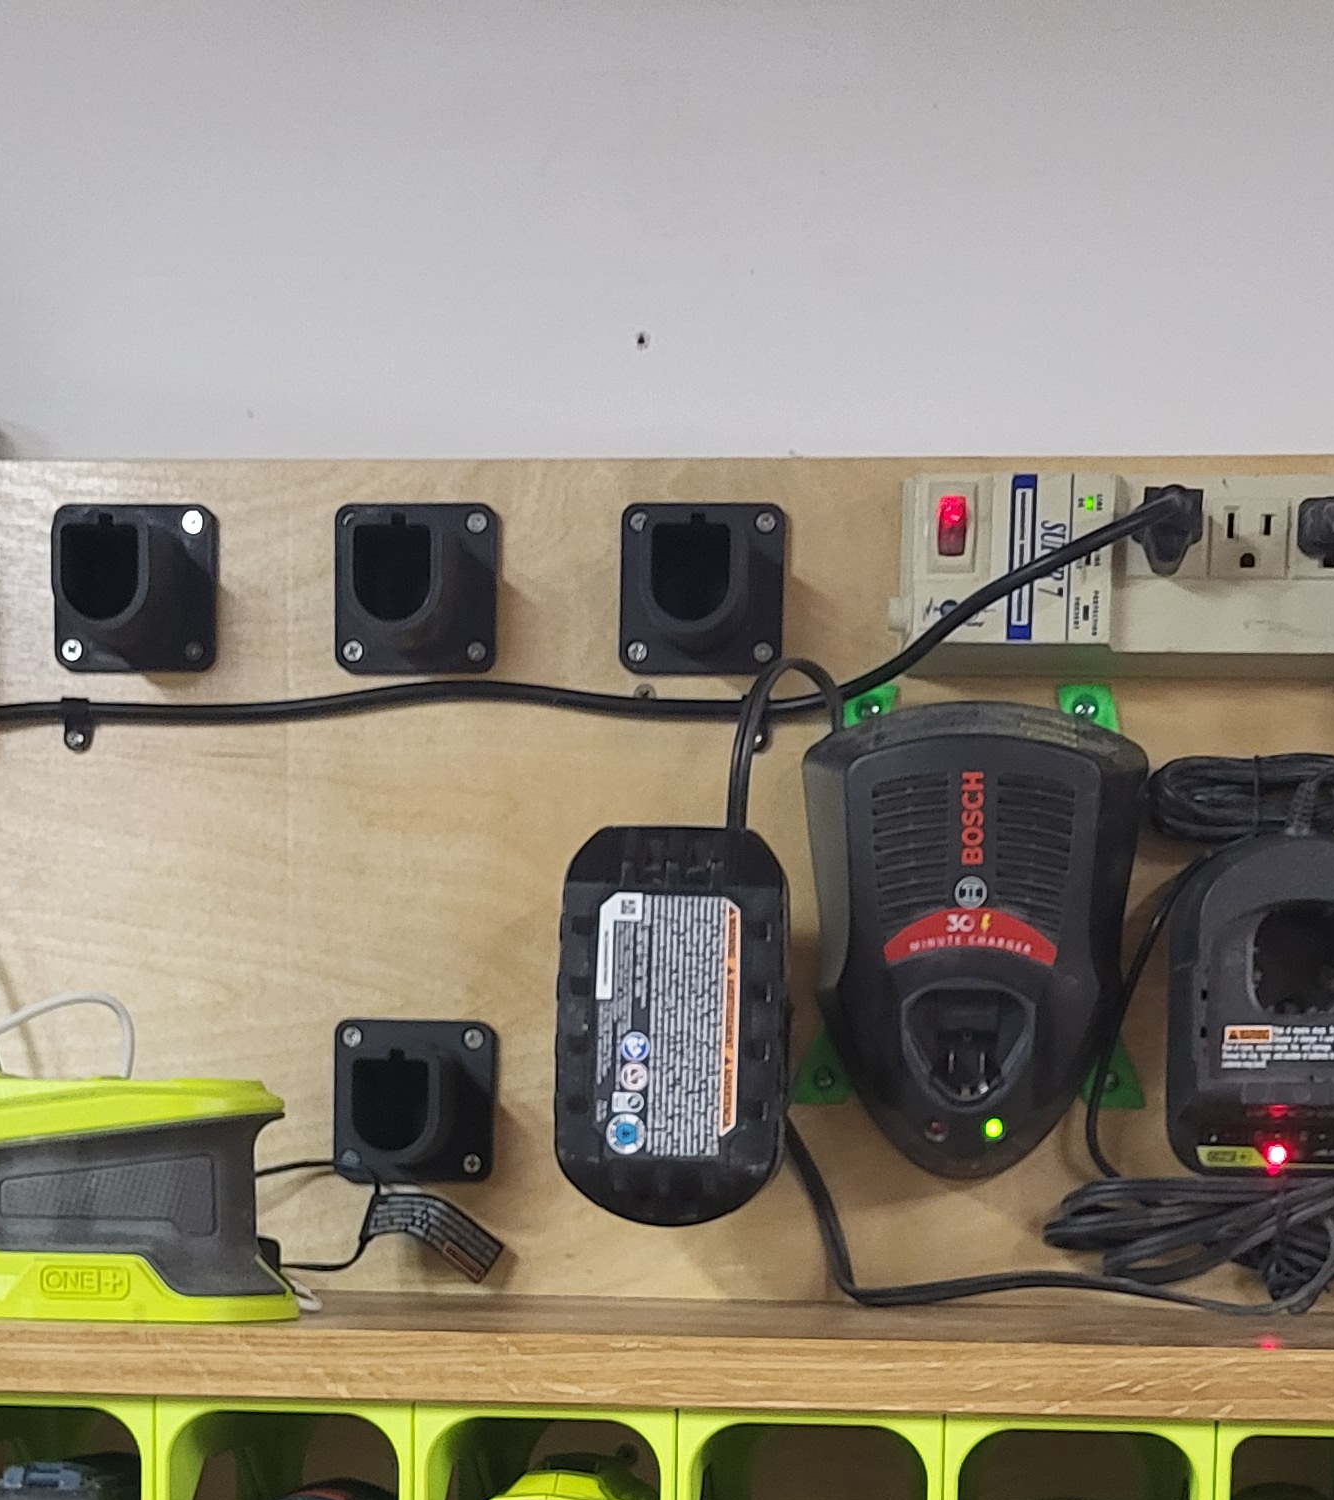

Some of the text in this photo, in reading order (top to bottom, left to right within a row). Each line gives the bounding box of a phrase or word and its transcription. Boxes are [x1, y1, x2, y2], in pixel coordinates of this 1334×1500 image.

[1038, 587, 1064, 598] 7
[961, 770, 984, 865] BOSCH
[945, 913, 976, 933] 30
[909, 933, 1032, 954] MINUTE CHARGER
